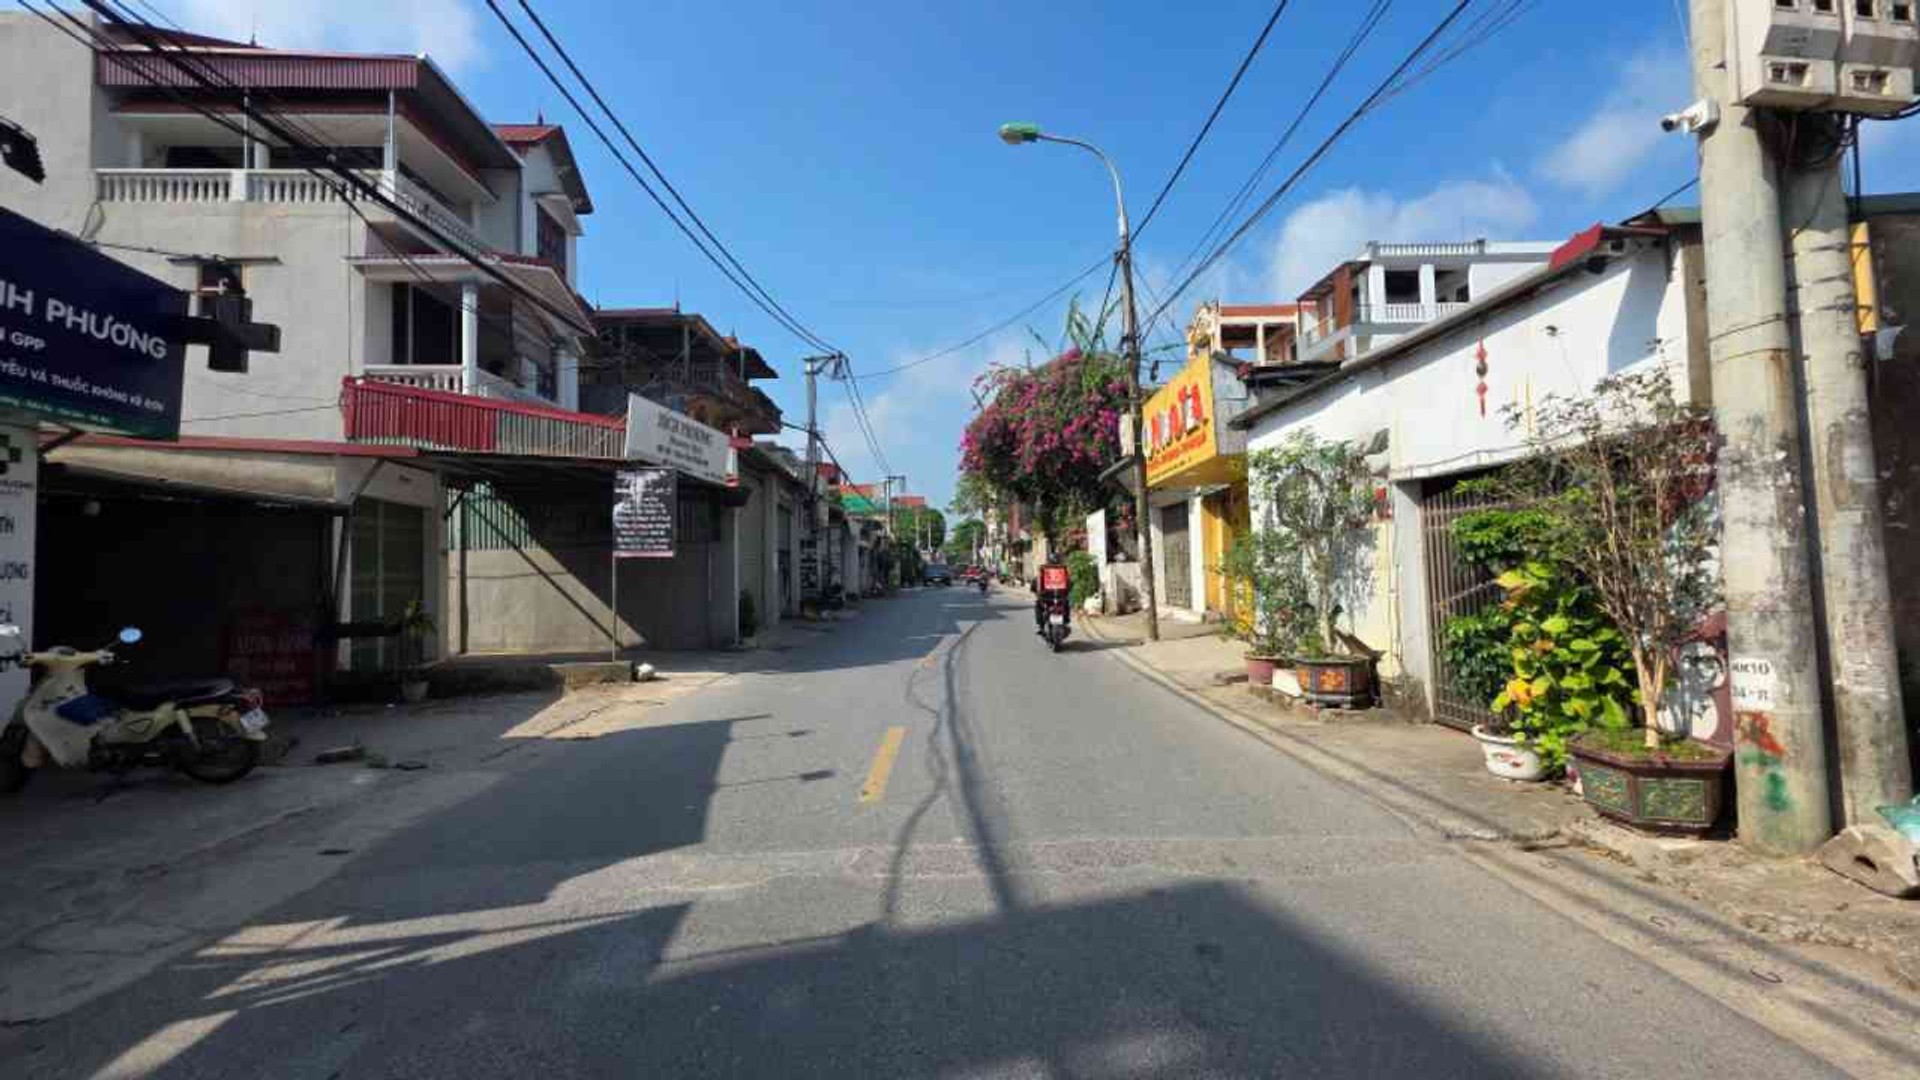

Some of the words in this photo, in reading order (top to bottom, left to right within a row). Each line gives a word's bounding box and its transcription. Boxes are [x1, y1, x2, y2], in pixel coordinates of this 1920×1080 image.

[0, 279, 33, 316] H
[46, 297, 168, 359] PHƯƠNG
[11, 331, 47, 350] GPP
